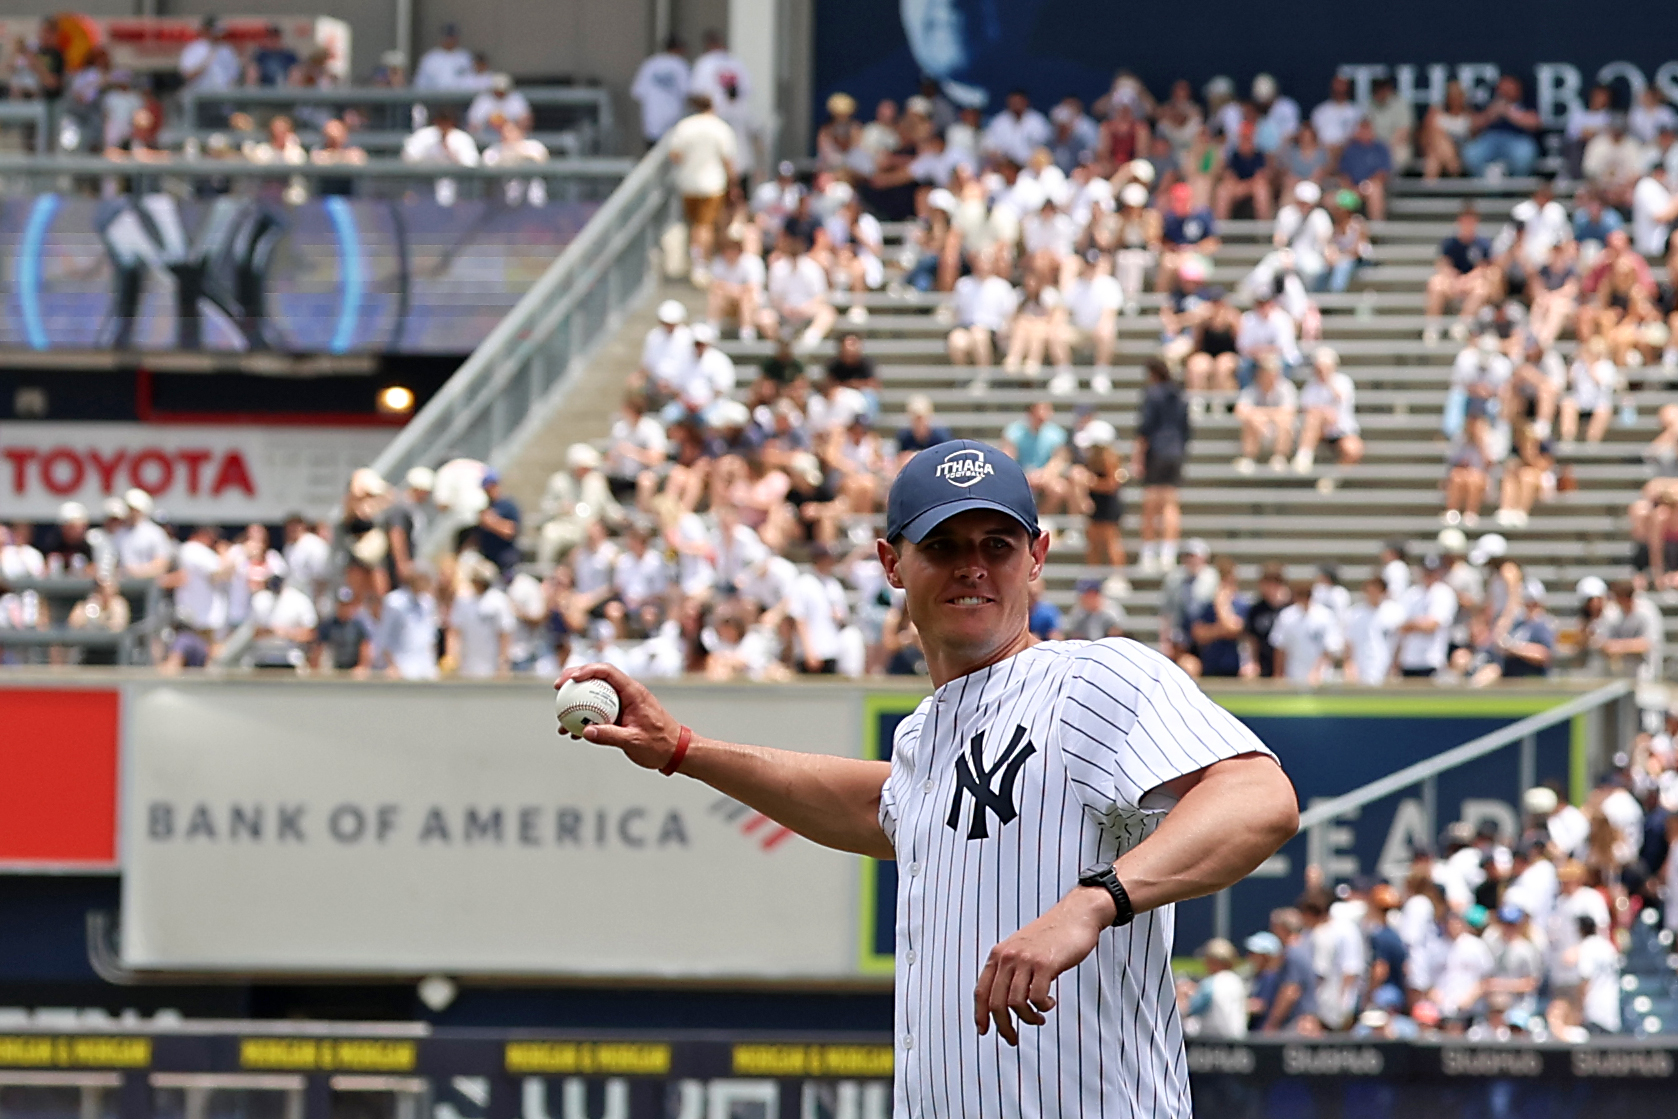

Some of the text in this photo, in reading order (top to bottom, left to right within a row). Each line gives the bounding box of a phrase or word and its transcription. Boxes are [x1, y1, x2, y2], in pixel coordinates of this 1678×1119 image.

[3, 446, 256, 498] TOYOTA
[935, 460, 995, 477] ITHACA
[945, 723, 1037, 841] NY
[146, 802, 692, 849] BANK OF AMERICA
